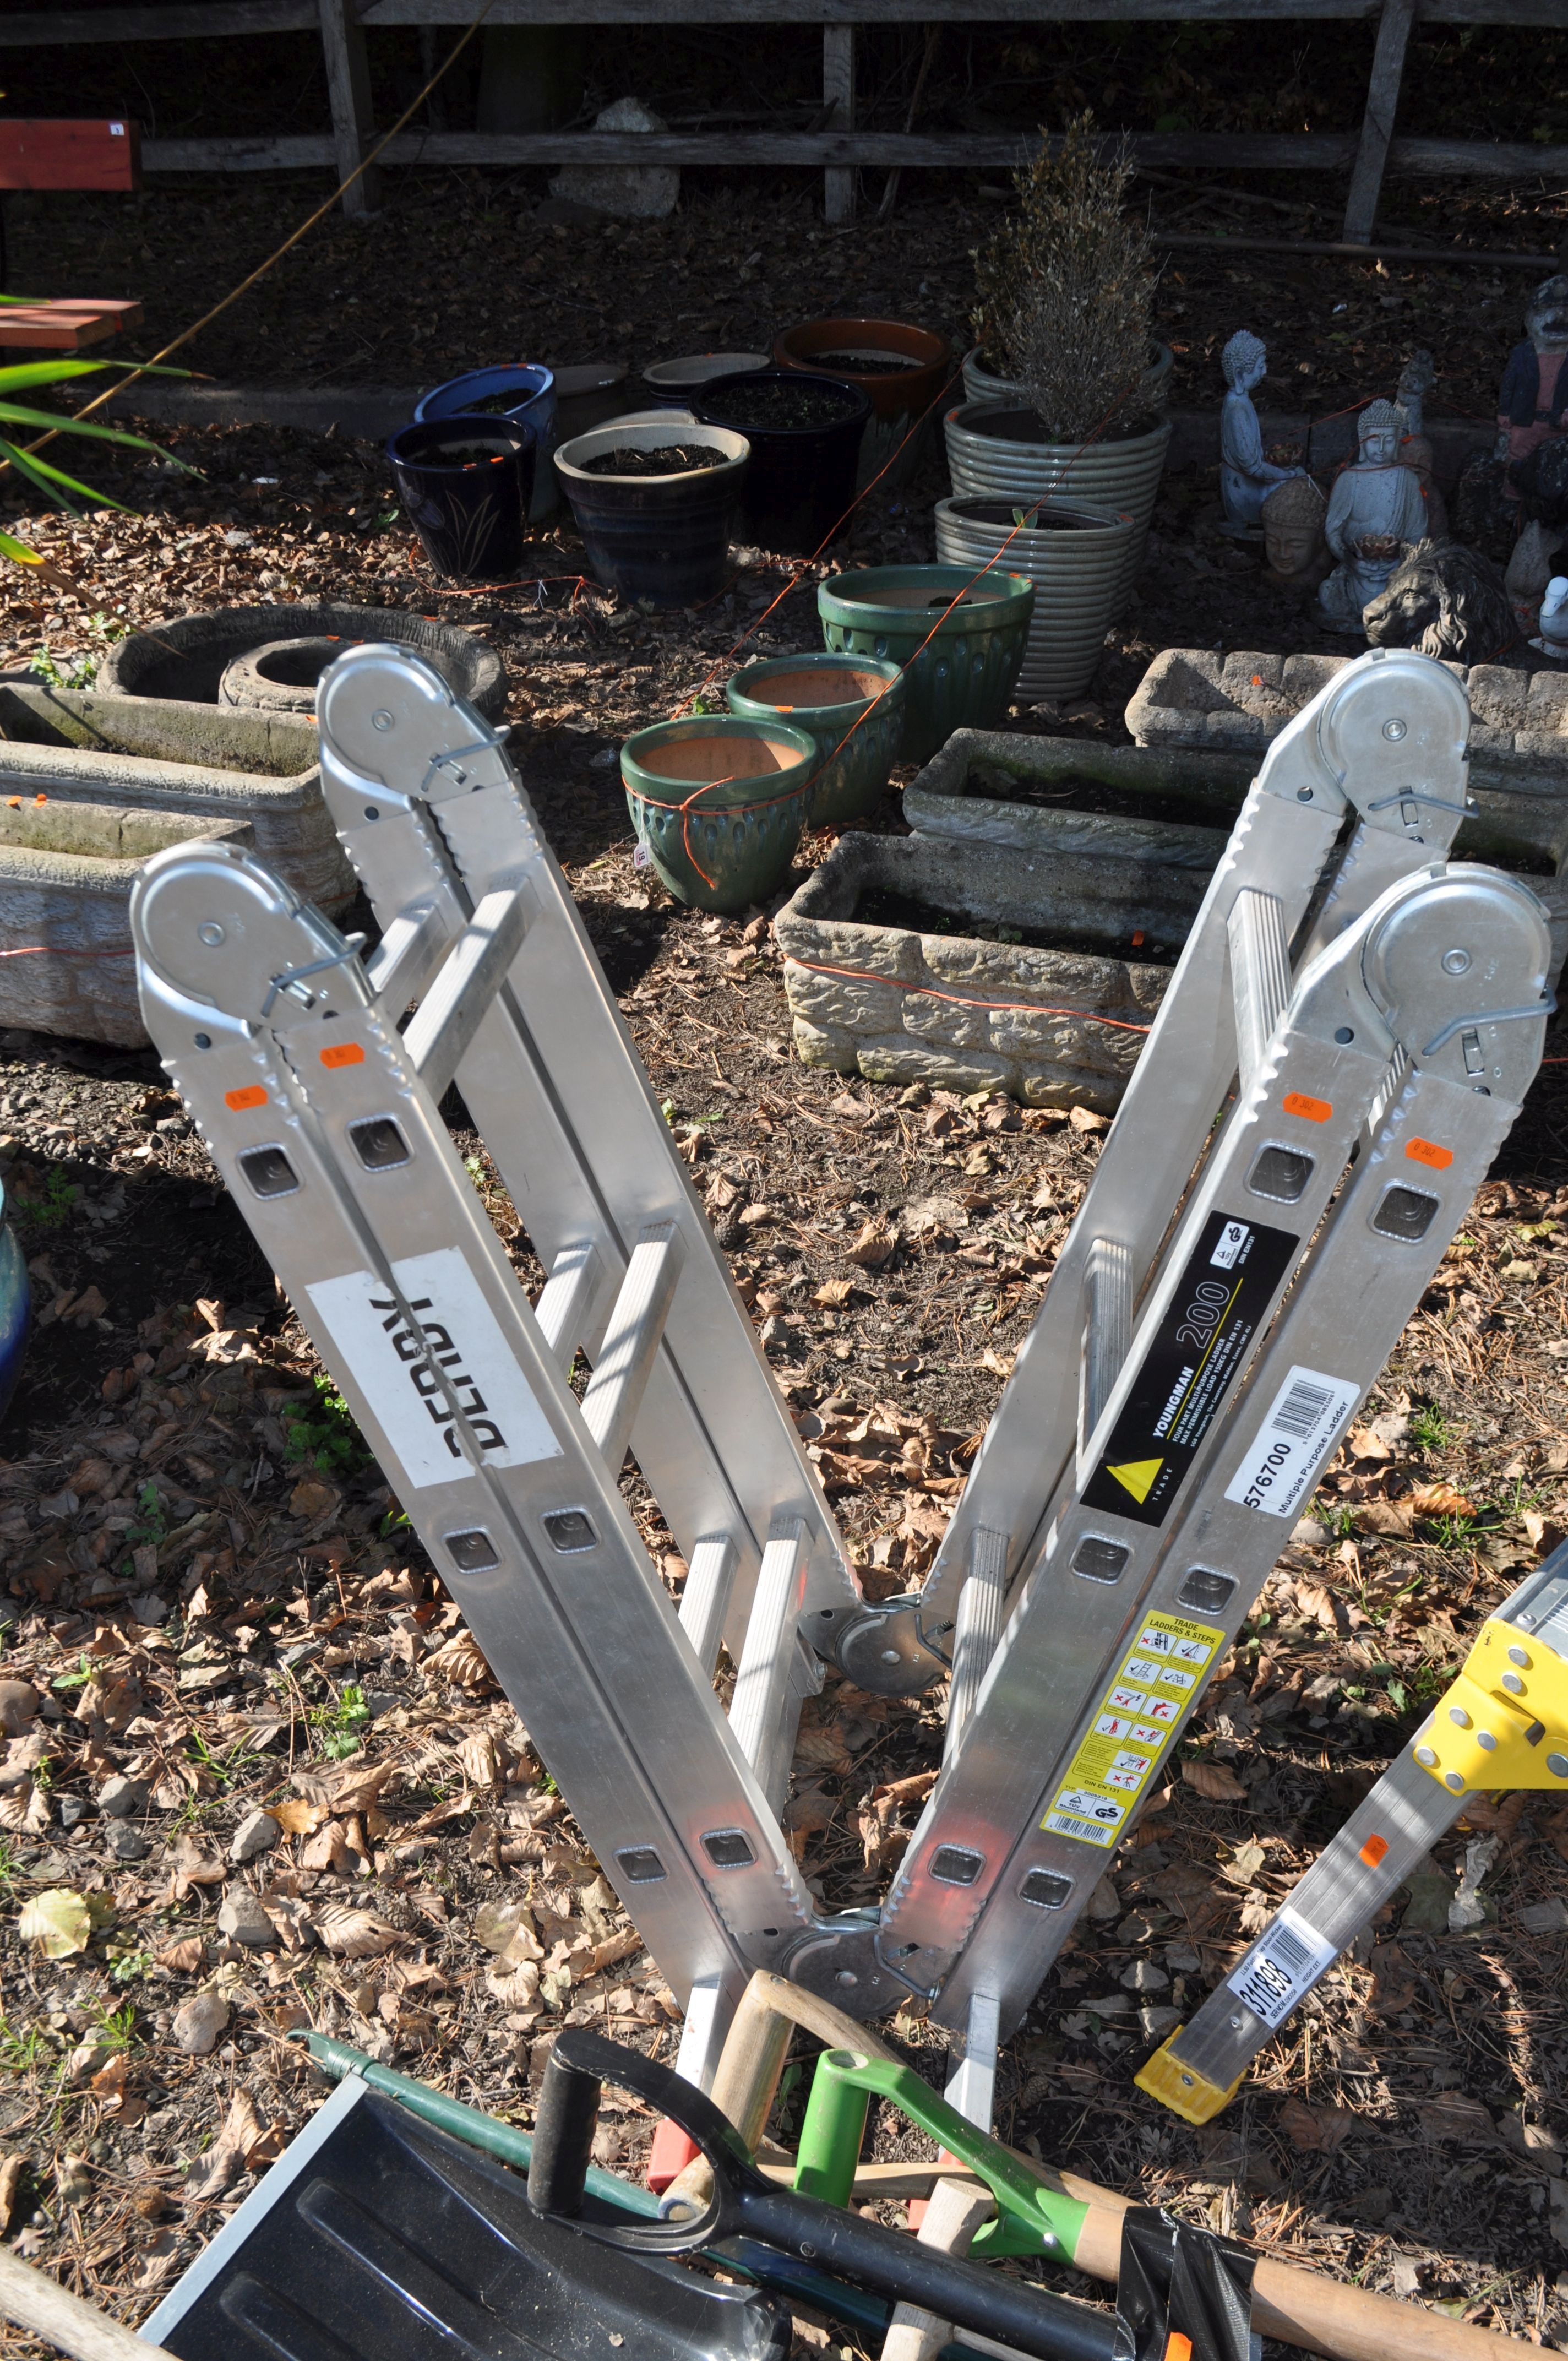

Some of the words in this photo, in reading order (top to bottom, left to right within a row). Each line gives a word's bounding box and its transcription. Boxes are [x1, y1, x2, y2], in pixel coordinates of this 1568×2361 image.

[1238, 1253, 1248, 1264] DIN
[1243, 1235, 1255, 1254] EN131
[368, 1297, 507, 1459] DERBY
[1152, 1366, 1194, 1438] YOUNGMAN
[1175, 1281, 1231, 1350] 200
[1172, 1426, 1184, 1442] FOUR
[1180, 1410, 1191, 1426] PART
[1210, 1338, 1226, 1363] LADDER
[1179, 1429, 1191, 1445] MAX
[1186, 1392, 1209, 1429] PERMISSIBLE
[1205, 1374, 1217, 1392] LOAD
[1213, 1354, 1227, 1373] 150KG
[1222, 1341, 1233, 1354] DIN
[1228, 1331, 1238, 1341] EN
[1233, 1319, 1243, 1331] 131
[1152, 1468, 1173, 1501] TRADE
[1243, 1443, 1291, 1509] 576700
[1278, 1477, 1304, 1514] Multiple
[1299, 1437, 1328, 1476] Purpose
[1323, 1401, 1348, 1435] Ladder
[1149, 1619, 1184, 1635] LADDERS
[1191, 1631, 1216, 1644] STEPS
[1174, 1618, 1199, 1631] TRADE
[1239, 1958, 1293, 2016] 311898
[1301, 1967, 1315, 1983] HEIGHT
